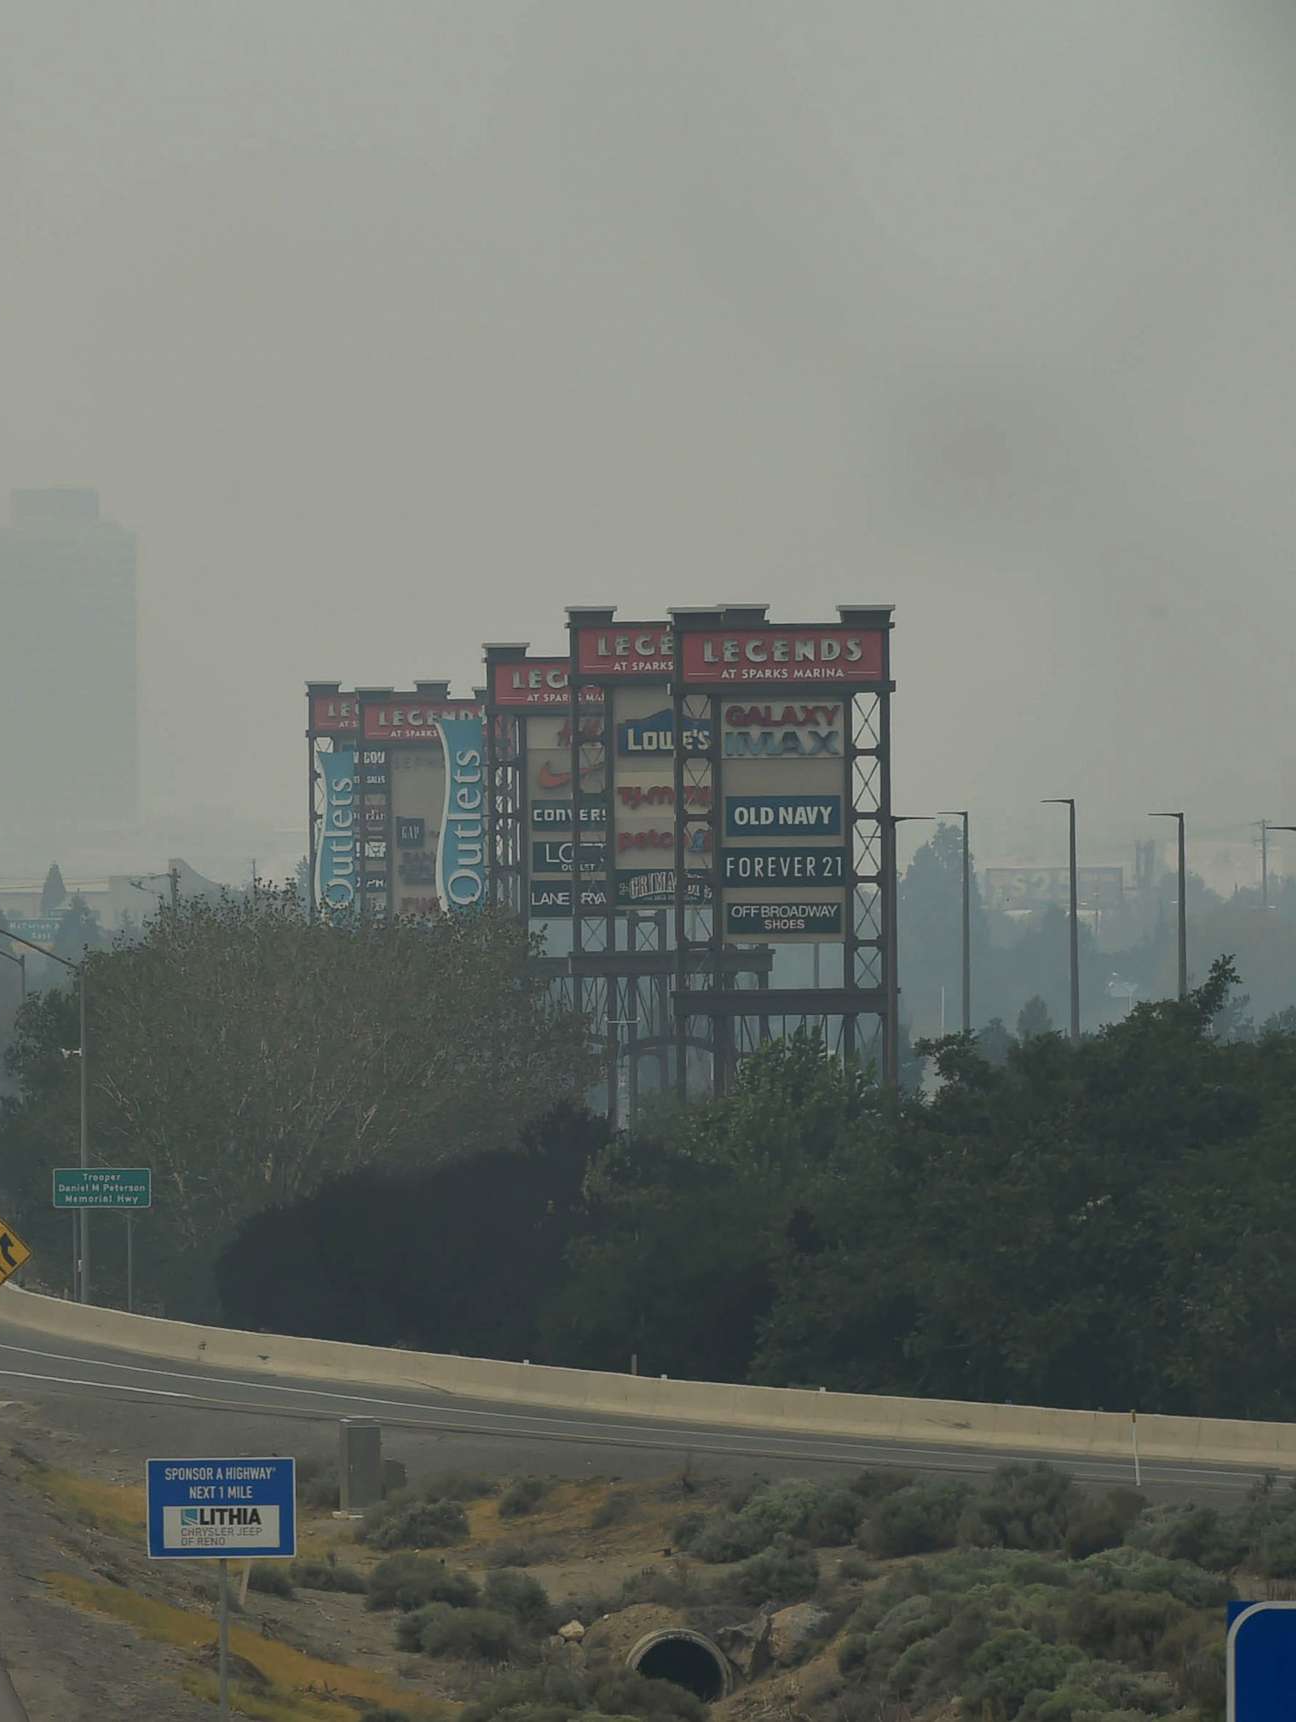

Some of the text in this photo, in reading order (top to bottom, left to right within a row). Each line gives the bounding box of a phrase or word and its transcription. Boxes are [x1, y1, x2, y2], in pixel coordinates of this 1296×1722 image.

[598, 635, 674, 656] LEGE
[704, 639, 863, 662] LEGENDS
[614, 661, 674, 671] AT SPARKS
[721, 667, 844, 679] AT SPARKS MARINA
[528, 694, 539, 702] AT
[725, 705, 841, 728] GALAXY
[406, 729, 437, 737] SPARKS
[725, 731, 839, 756] IMAX
[734, 806, 833, 825] OLD NAVY
[448, 749, 482, 905] Outlets
[324, 777, 354, 909] Outlets
[561, 863, 596, 871] OULET
[726, 857, 843, 878] FOREVER 21
[531, 892, 570, 905] LANE
[764, 919, 805, 930] SHOES
[83, 1173, 121, 1182] Trooper
[58, 1184, 89, 1192] Daniel
[104, 1184, 146, 1192] Peterson
[65, 1195, 138, 1204] Memorial Hwy
[164, 1467, 213, 1480] SPONSOR
[216, 1468, 224, 1480] A
[189, 1486, 253, 1499] NEXT 1 MILE
[200, 1508, 261, 1525] LITHIA
[180, 1527, 262, 1537] CHRYSLER JEEP
[181, 1537, 226, 1546] OF RENO
